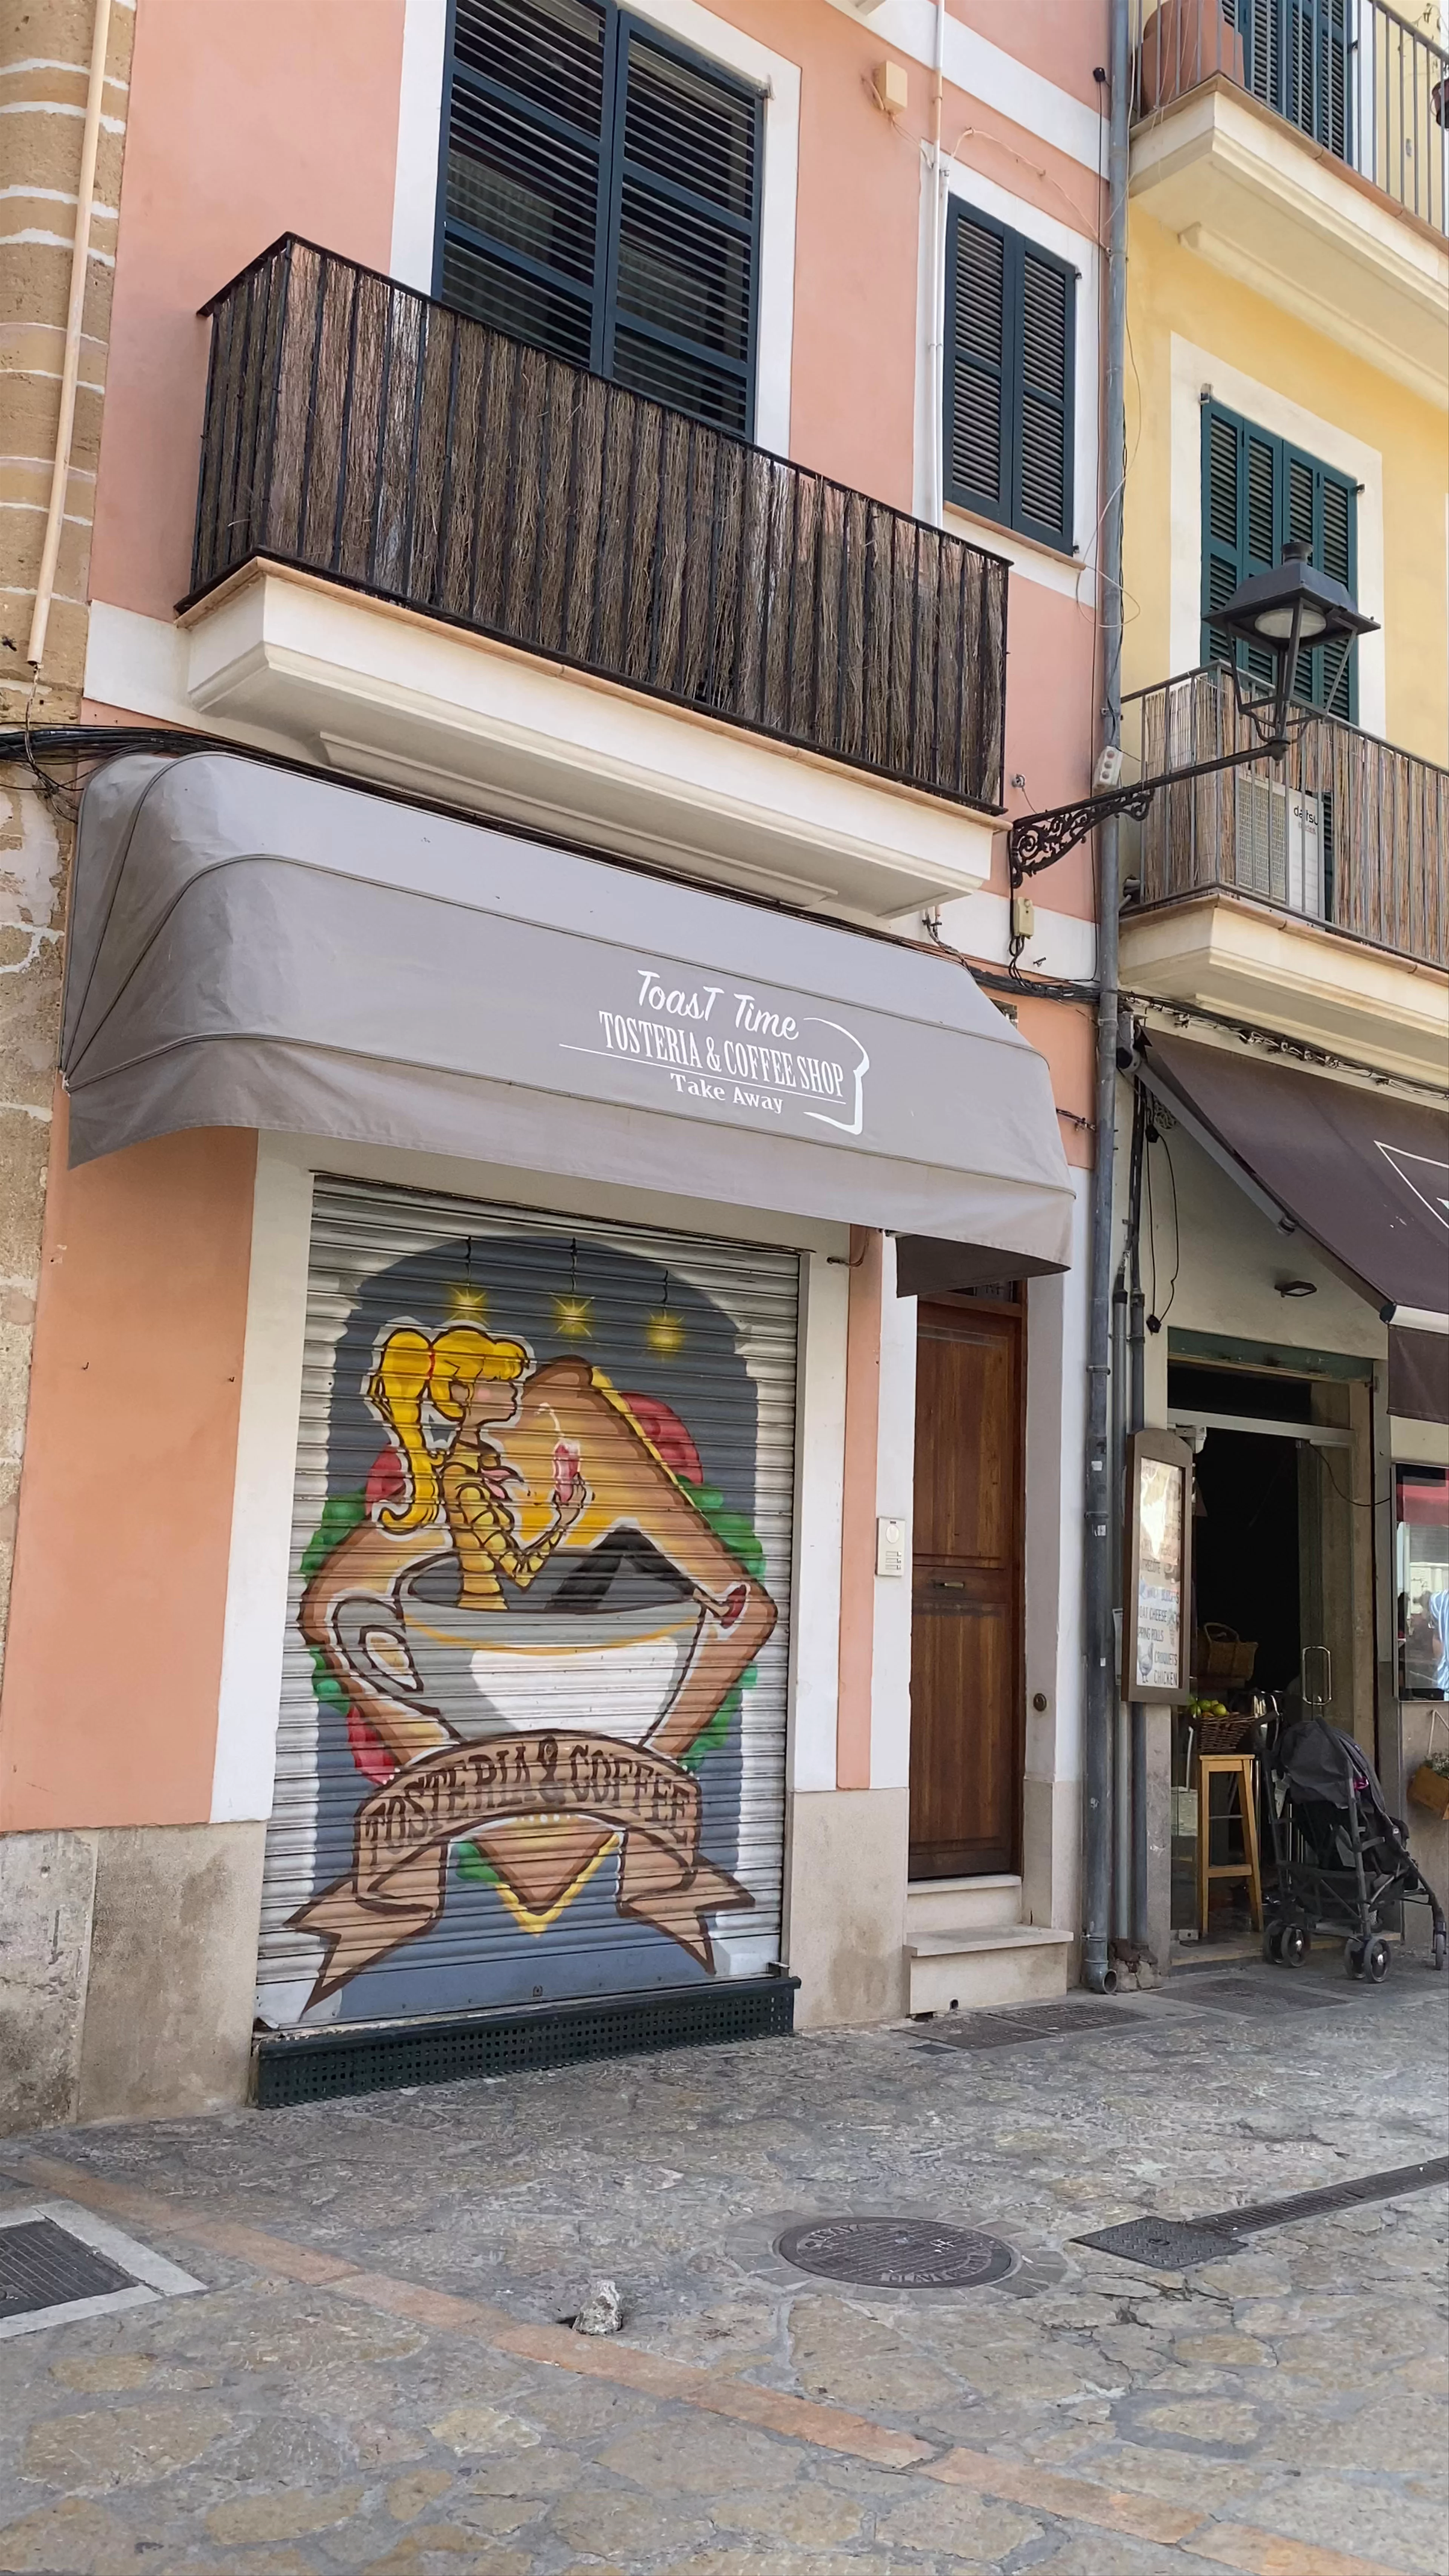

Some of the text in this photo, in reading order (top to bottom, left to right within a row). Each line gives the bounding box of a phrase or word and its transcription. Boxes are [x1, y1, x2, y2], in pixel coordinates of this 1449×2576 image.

[1294, 805, 1319, 826] datsu
[734, 993, 799, 1040] Time
[598, 1010, 844, 1097] TOSTERIA & COFFEE SHOP
[670, 1073, 783, 1114] Take Away
[1149, 1607, 1168, 1622] CHEESE
[1154, 1670, 1177, 1686] CHICKEN
[365, 1735, 690, 1876] TOSTERIA & COFFEE
